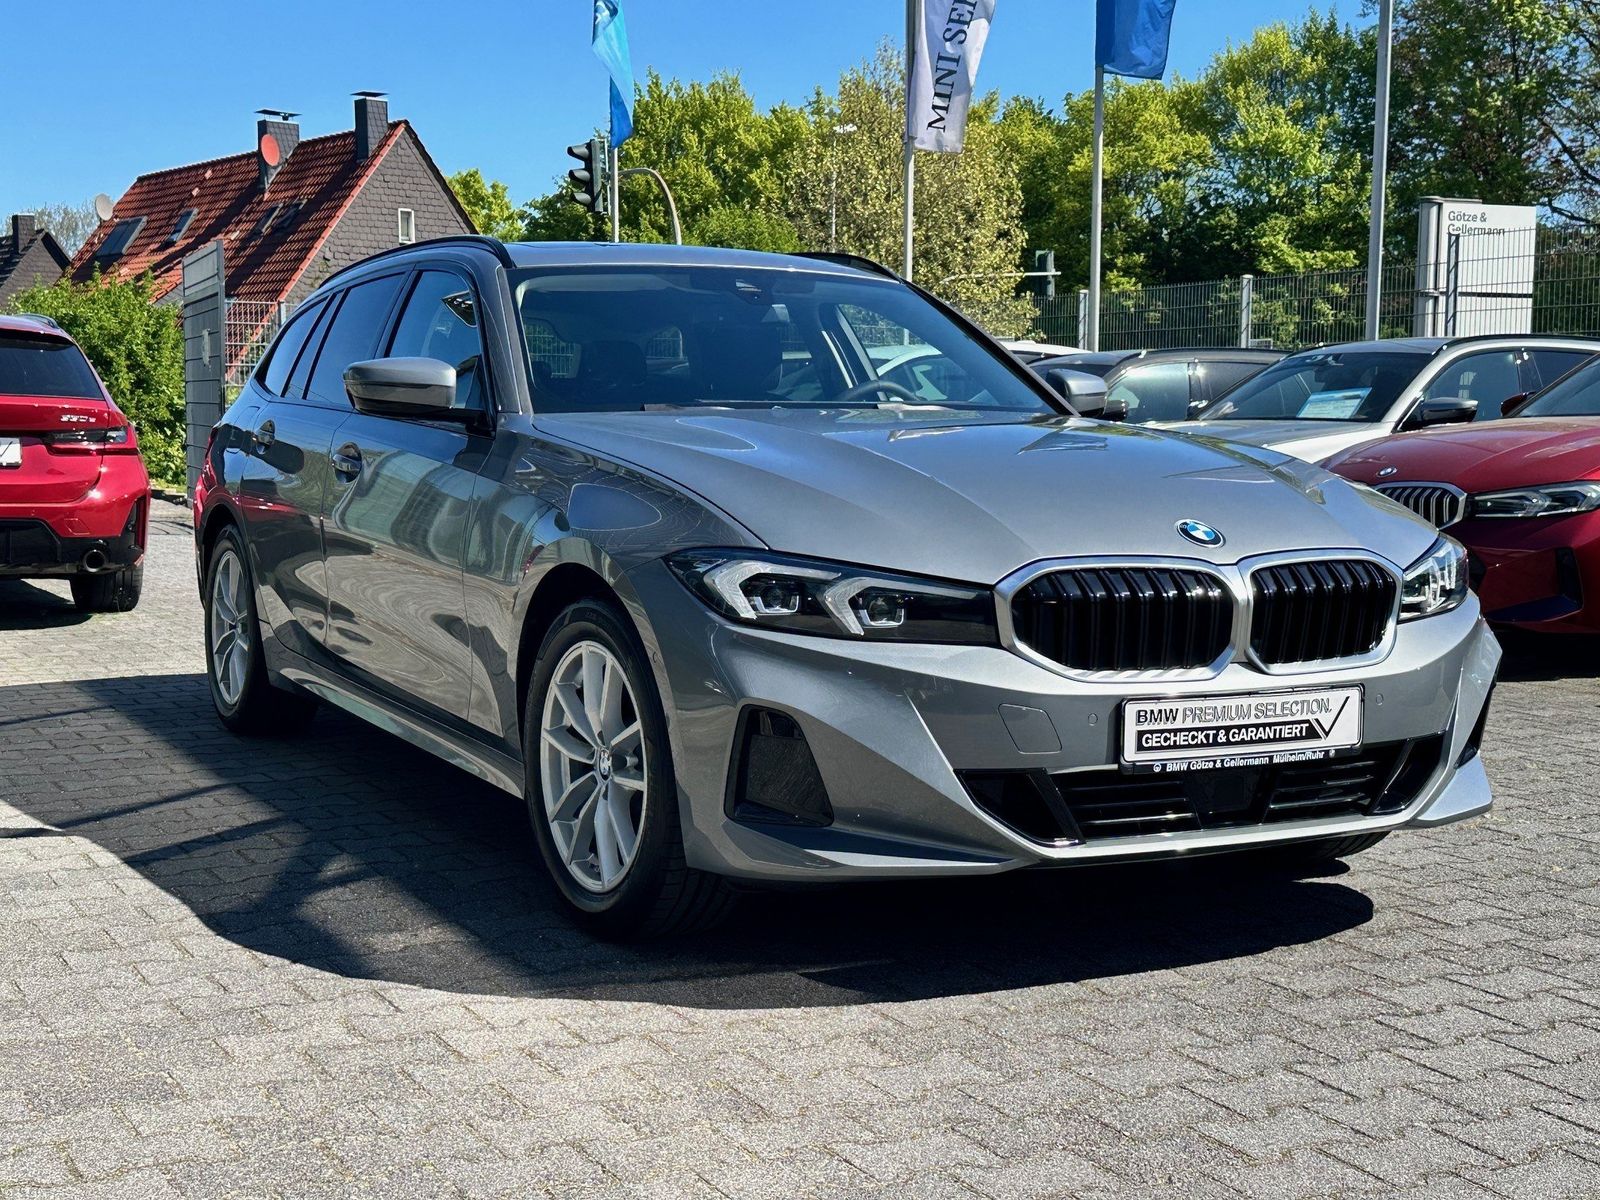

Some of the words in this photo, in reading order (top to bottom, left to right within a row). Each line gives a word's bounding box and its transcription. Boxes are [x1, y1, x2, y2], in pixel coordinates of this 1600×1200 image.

[926, 52, 961, 133] MINI
[1448, 210, 1478, 222] Götze
[1479, 211, 1487, 222] &
[1136, 708, 1179, 726] BMW
[1183, 705, 1251, 724] PREMIUM
[1142, 731, 1216, 747] GECHECKT
[1217, 730, 1227, 743] &
[1229, 724, 1309, 741] GARANTIERT
[1166, 761, 1188, 772] BMW
[1189, 759, 1213, 770] Götze
[1215, 759, 1222, 768] &
[1223, 757, 1269, 767] Gellermann
[1272, 750, 1325, 764] Mülheim/Ruhr
